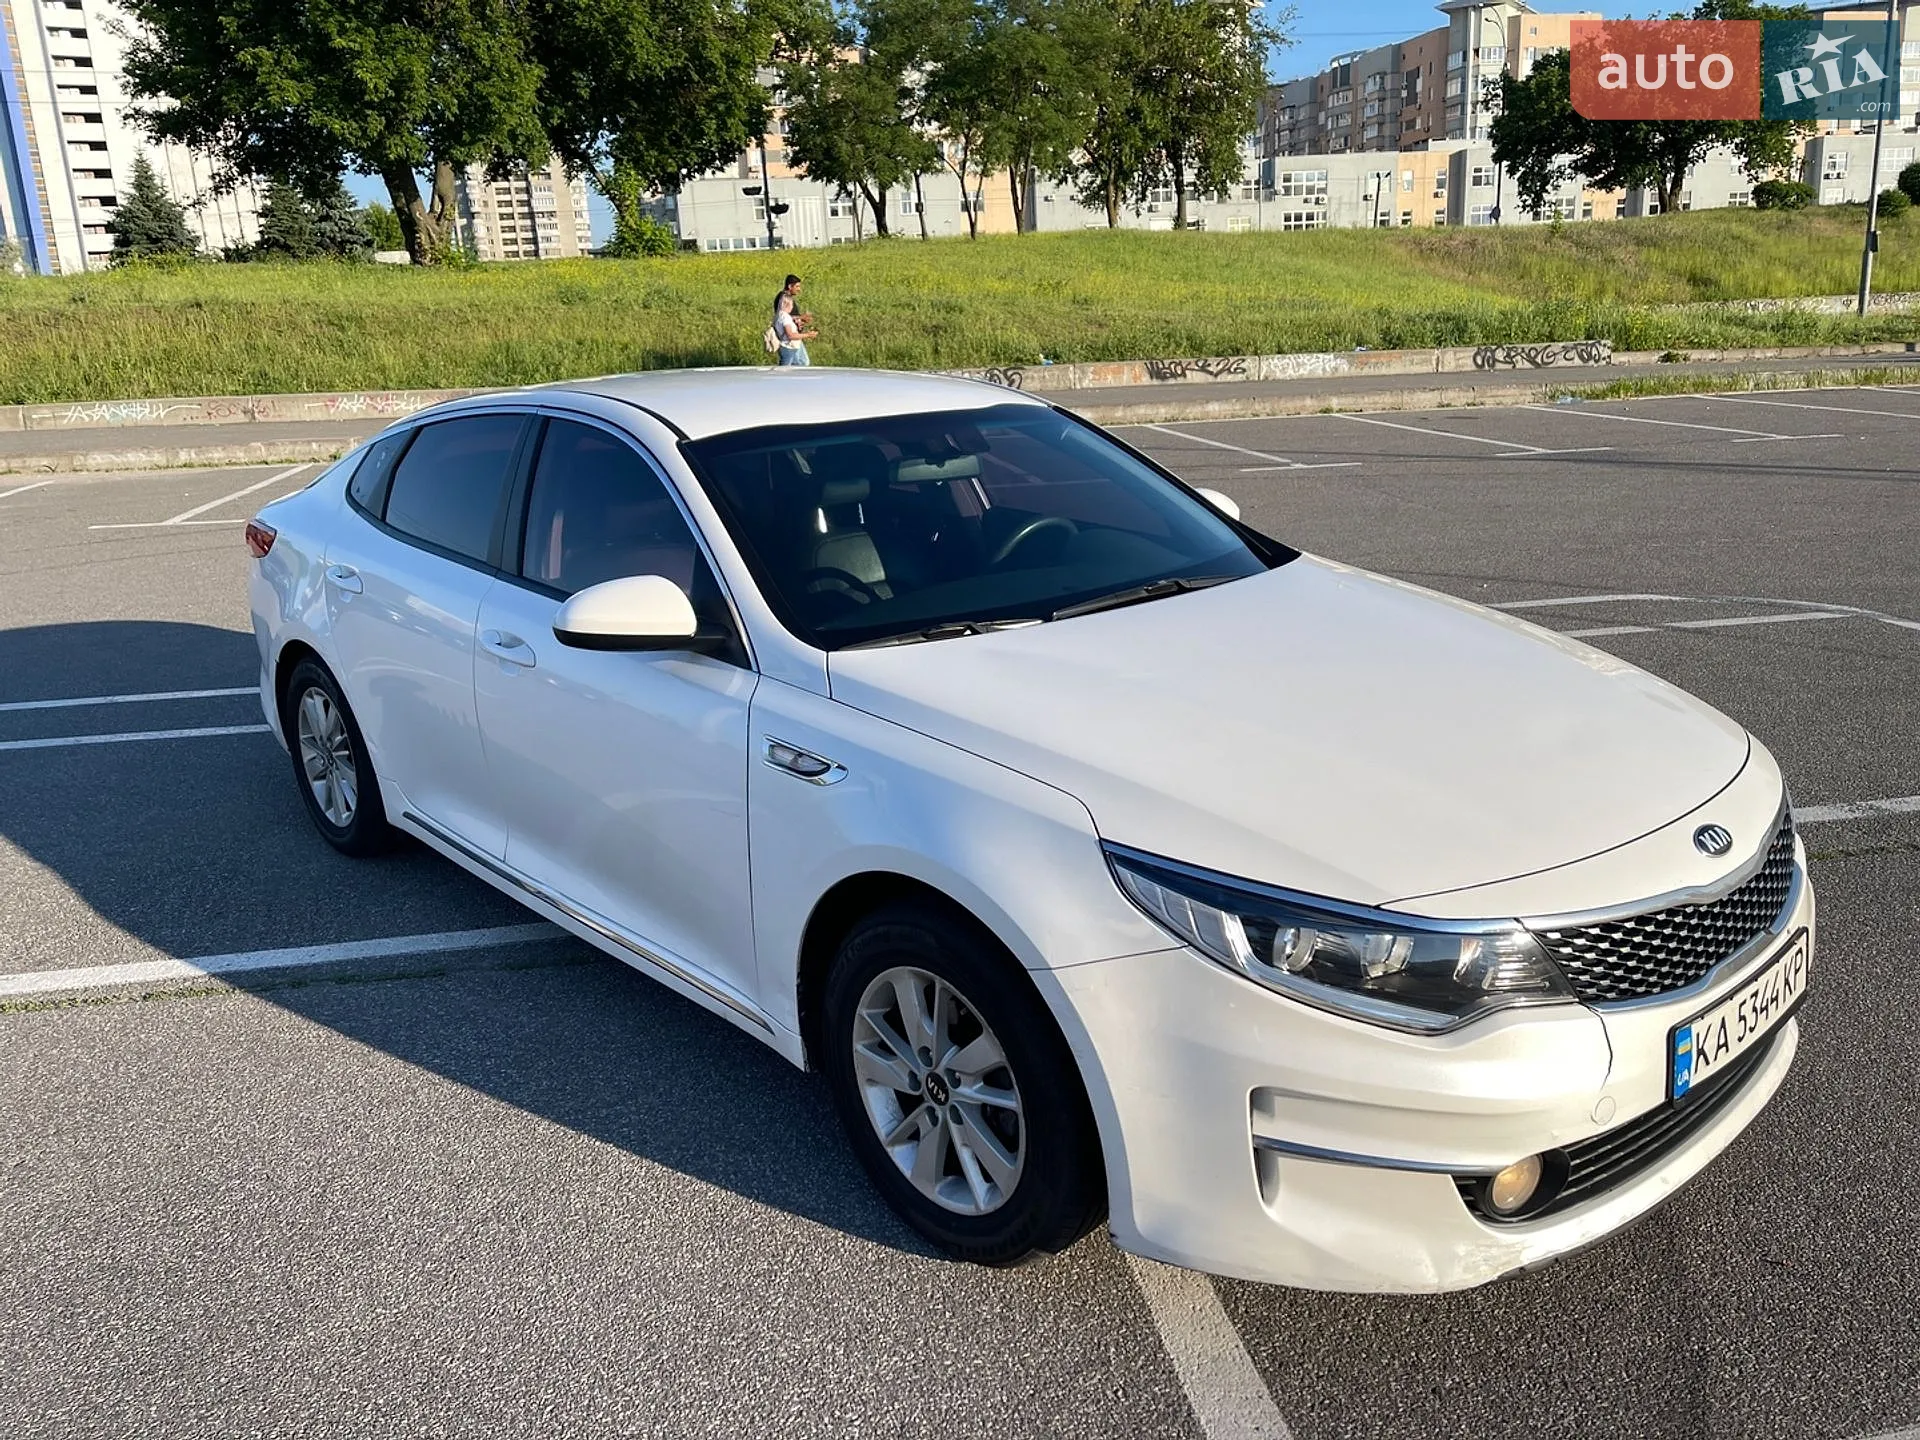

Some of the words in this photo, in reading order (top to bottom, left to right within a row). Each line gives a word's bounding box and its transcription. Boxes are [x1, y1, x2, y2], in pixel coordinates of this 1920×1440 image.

[1698, 826, 1731, 853] KIA
[1694, 1015, 1730, 1074] KA
[1737, 970, 1780, 1043] 5344
[1783, 946, 1804, 1004] KP
[928, 1077, 946, 1102] KIA
